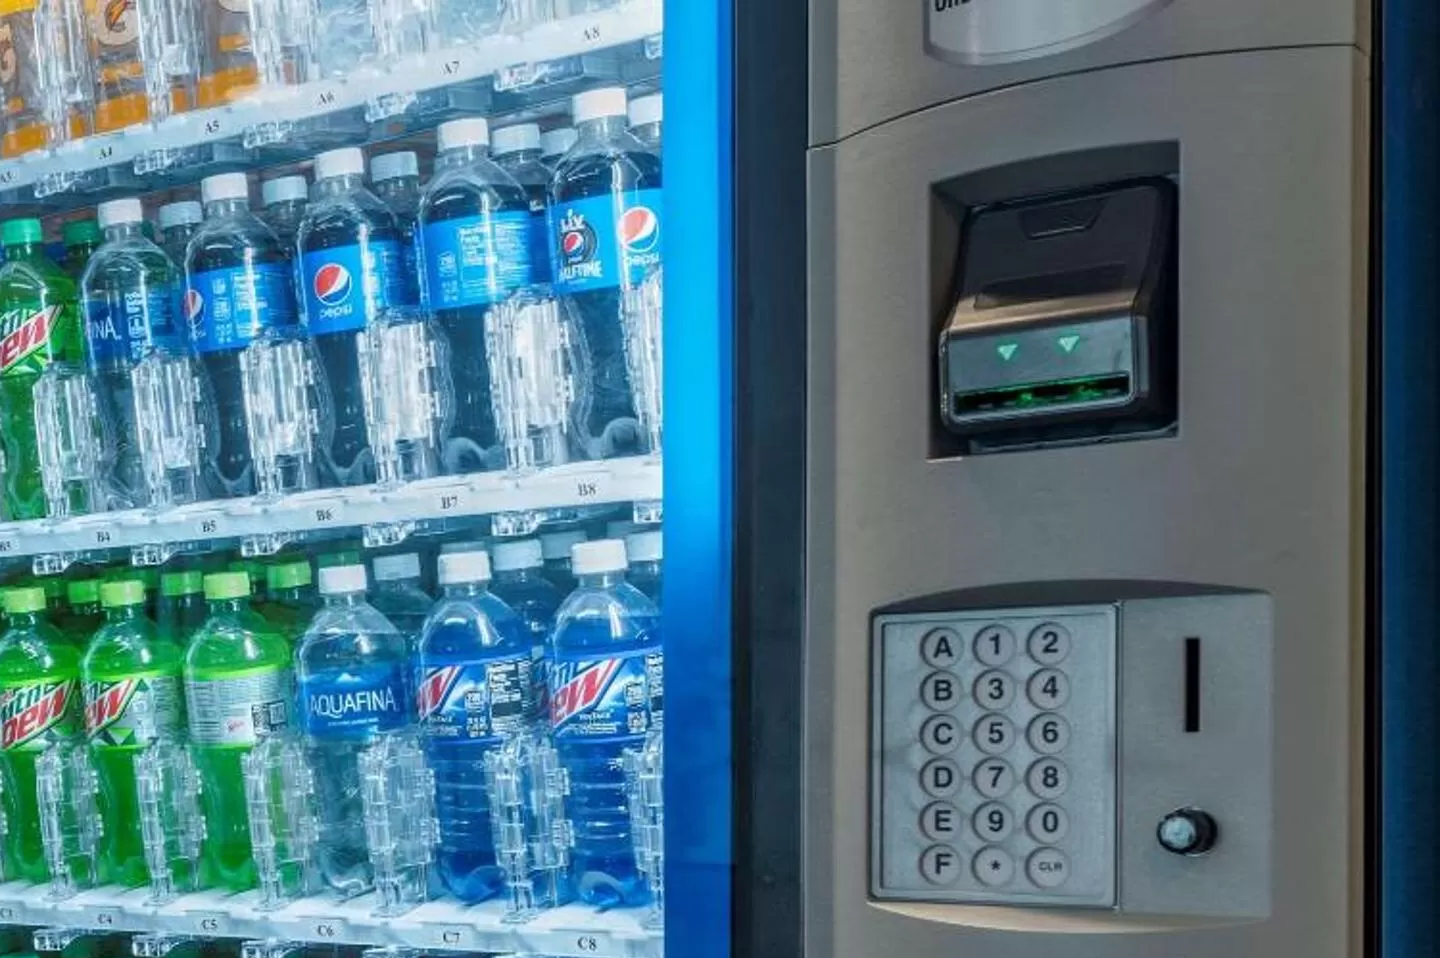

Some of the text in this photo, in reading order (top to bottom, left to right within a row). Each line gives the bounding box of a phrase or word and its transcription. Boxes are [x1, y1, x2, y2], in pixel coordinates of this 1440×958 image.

[583, 26, 601, 41] A8
[443, 61, 460, 75] A7
[318, 92, 335, 106] A6
[203, 119, 220, 134] A5
[98, 146, 113, 159] A4
[578, 482, 596, 497] B8
[441, 496, 458, 509] B7
[317, 509, 333, 521] B6
[202, 521, 217, 533] B5
[96, 531, 111, 543] B4
[933, 631, 1059, 659] A 1 2
[934, 675, 1059, 701] B 3 4
[310, 685, 397, 718] AQUAFINA
[933, 720, 1059, 746] C 5 6
[934, 765, 1059, 789] D 7 8
[935, 809, 1059, 834] E 9 0
[935, 853, 951, 875] F
[98, 913, 112, 925] C4
[201, 918, 217, 930] C5
[318, 924, 334, 938] C6
[443, 932, 460, 944] C7
[578, 936, 596, 951] C8
